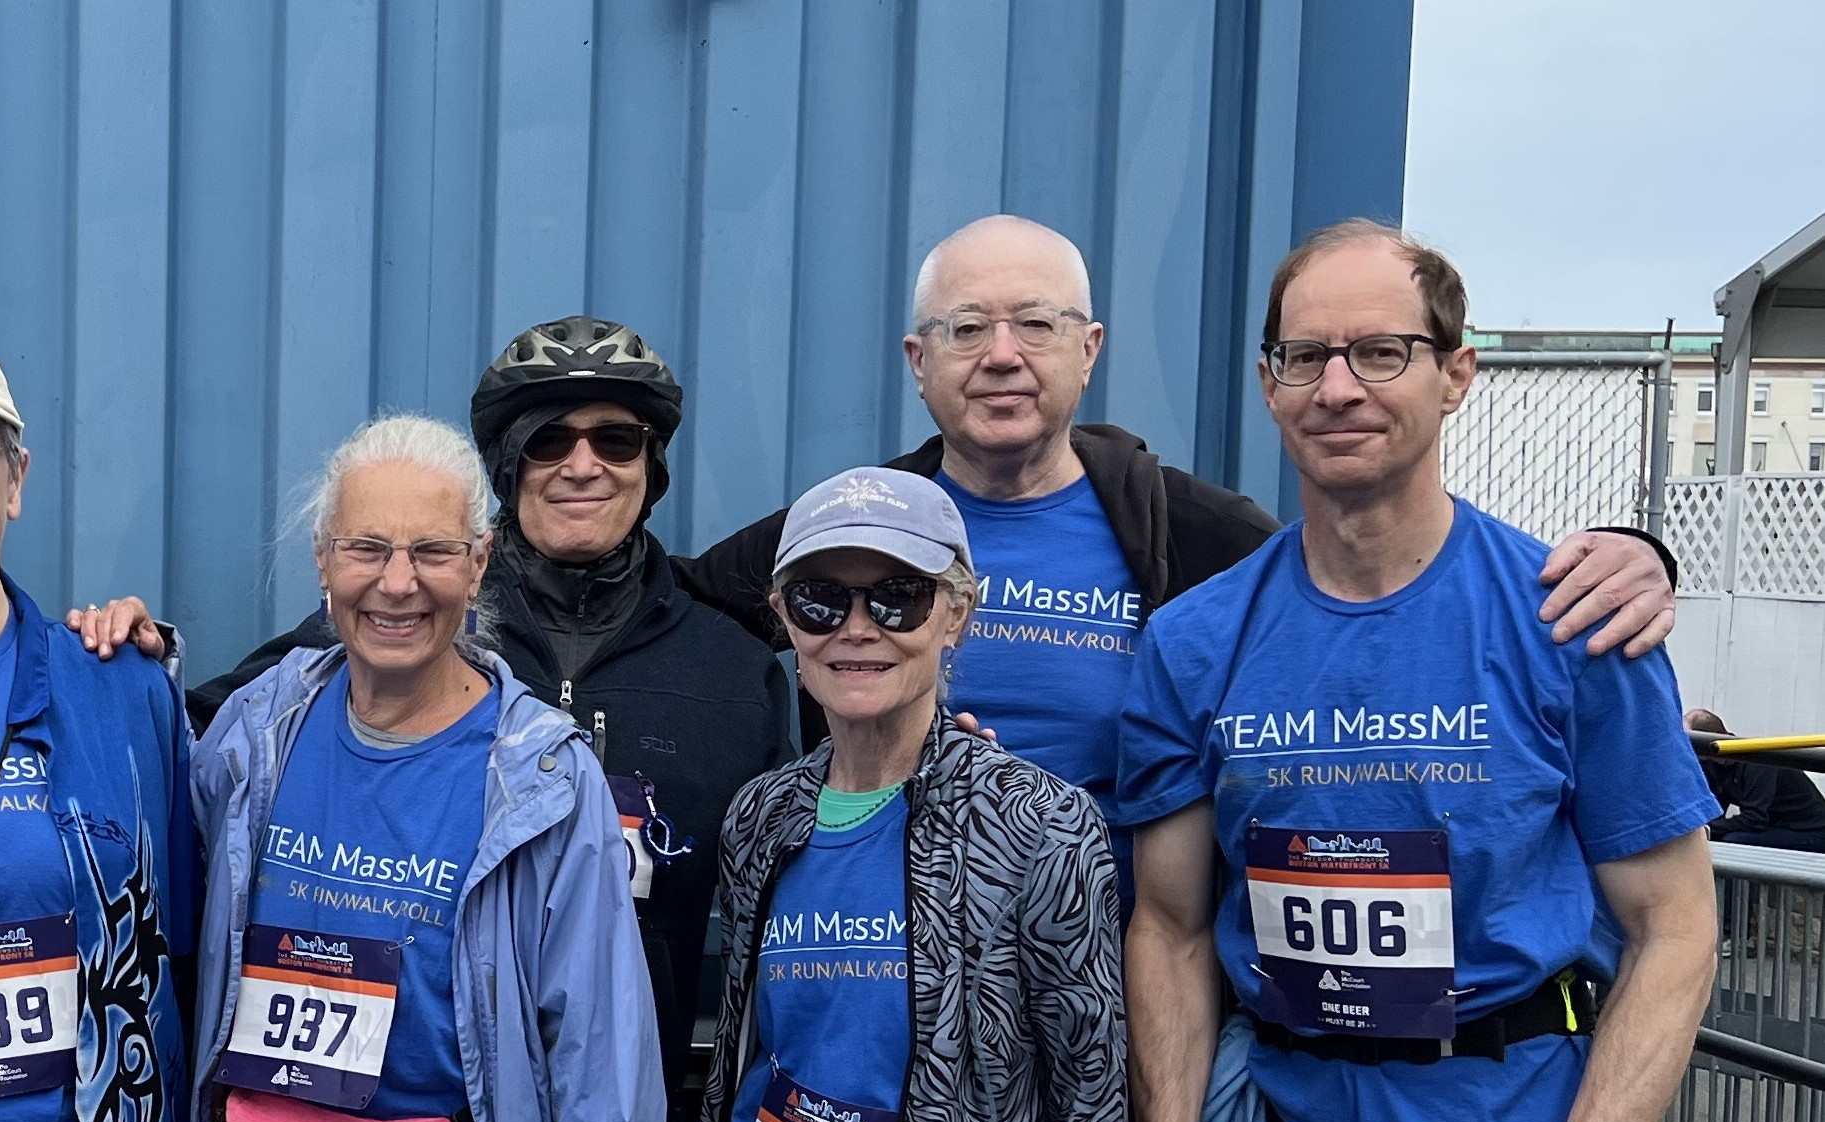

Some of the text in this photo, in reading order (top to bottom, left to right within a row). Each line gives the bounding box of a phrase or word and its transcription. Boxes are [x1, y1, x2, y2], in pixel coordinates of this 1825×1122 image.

[1002, 577, 1141, 621] MassME
[970, 621, 1136, 655] RUN/WALK/ROLL
[1214, 704, 1489, 749] TEAM MassME
[1267, 761, 1492, 788] 5K RUN/WALK/ROLL
[331, 843, 459, 893] MassME
[288, 880, 308, 900] 5K
[761, 910, 907, 948] EAM MassM
[1283, 896, 1407, 957] 606
[792, 960, 909, 981] RUN/WALK/RO
[263, 993, 357, 1057] 937
[1321, 1001, 1370, 1017] ONE BEER
